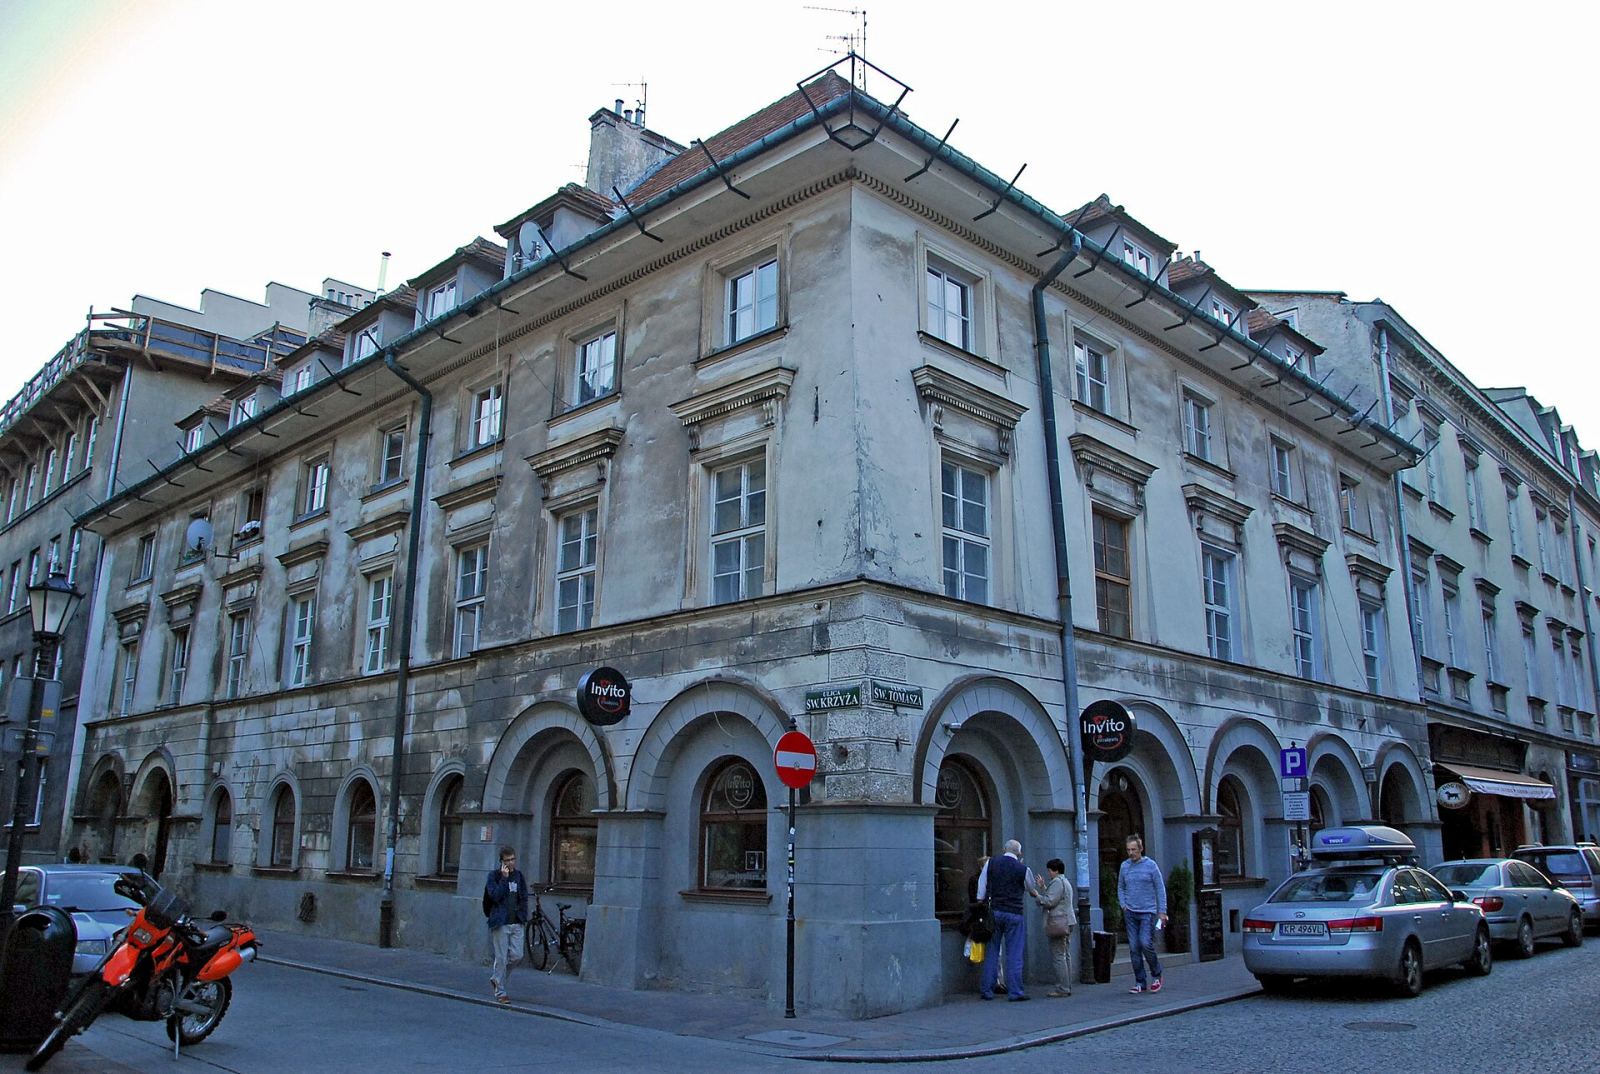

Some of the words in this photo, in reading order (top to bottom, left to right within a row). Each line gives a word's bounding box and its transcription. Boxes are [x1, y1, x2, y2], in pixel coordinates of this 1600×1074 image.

[820, 692, 858, 708] KRZYŻA
[888, 690, 922, 706] TOMASZA
[1285, 751, 1301, 774] P
[1284, 925, 1296, 933] KR
[1297, 925, 1323, 934] 496VL
